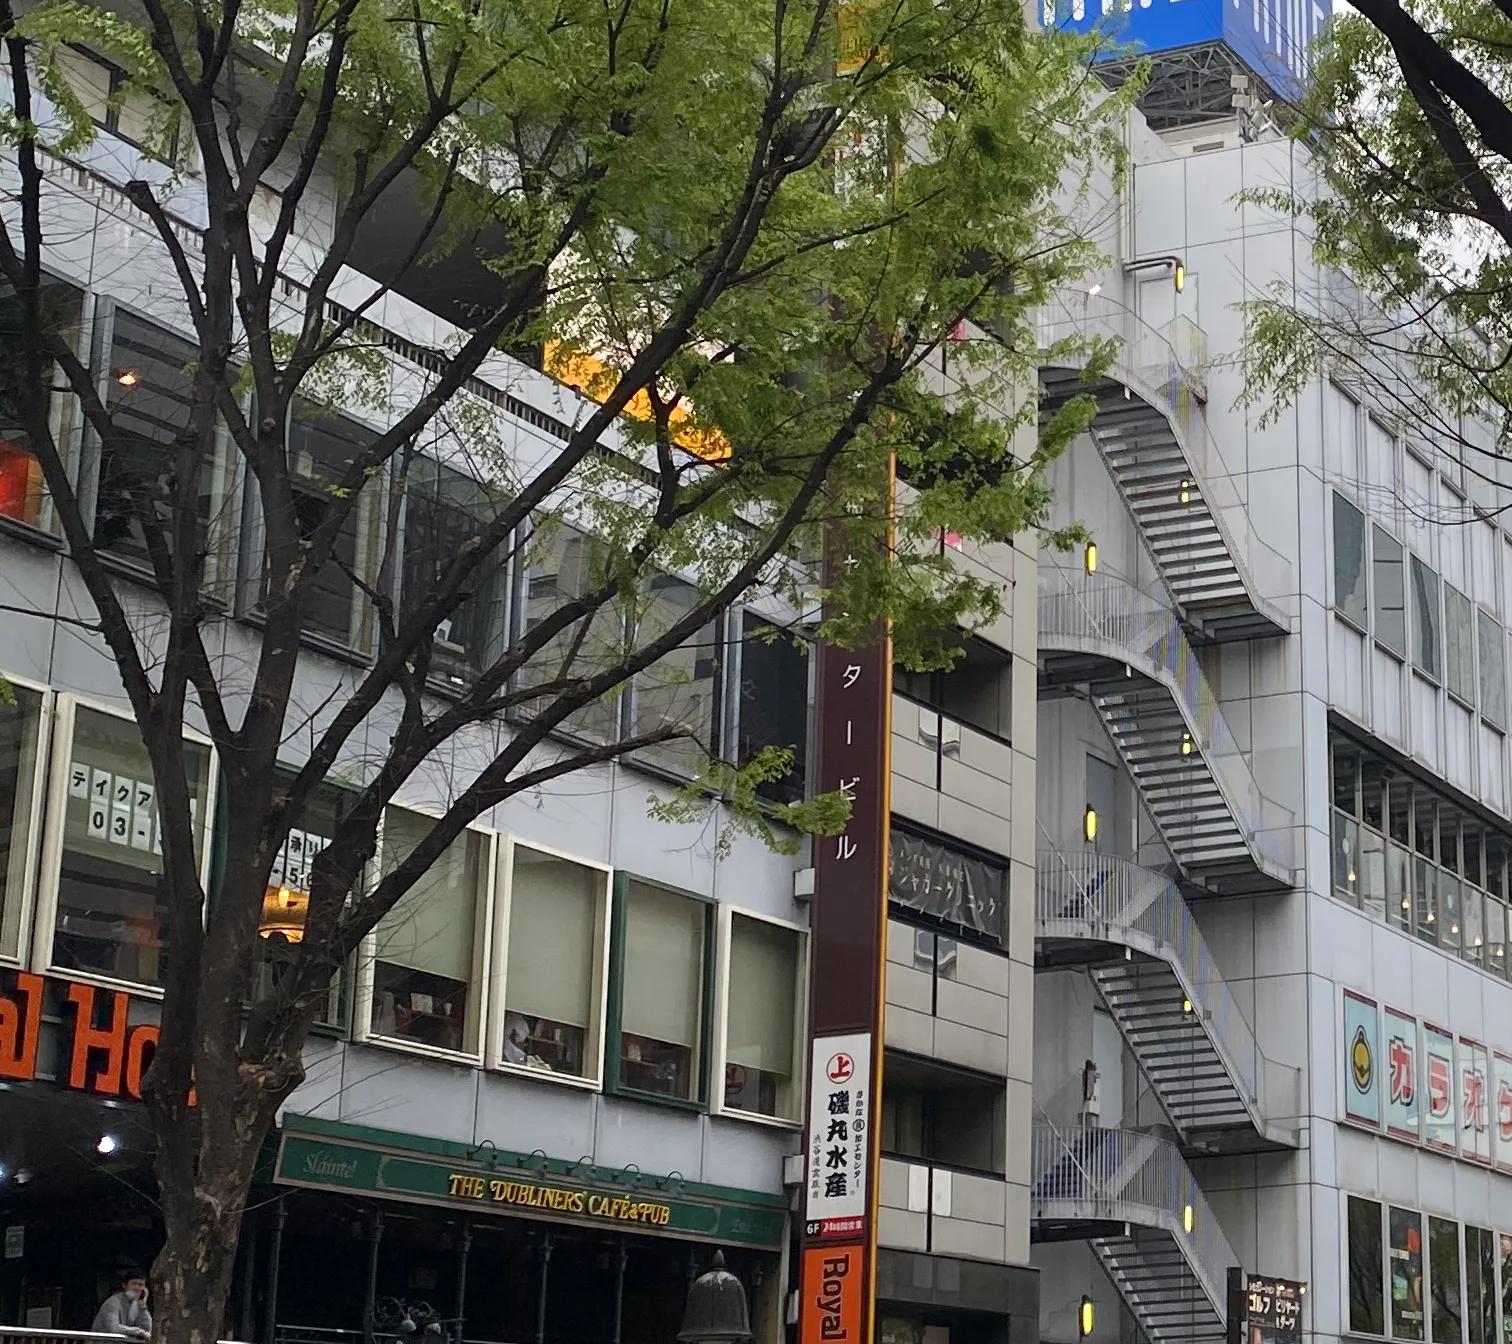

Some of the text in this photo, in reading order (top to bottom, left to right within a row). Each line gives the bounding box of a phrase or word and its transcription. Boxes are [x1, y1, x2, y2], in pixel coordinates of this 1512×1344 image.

[825, 1090, 850, 1198] 磯丸水産
[447, 1173, 484, 1200] THE
[806, 1221, 820, 1235] 6F
[820, 1254, 850, 1343] Royal
[1249, 1293, 1271, 1314] ゴルフ
